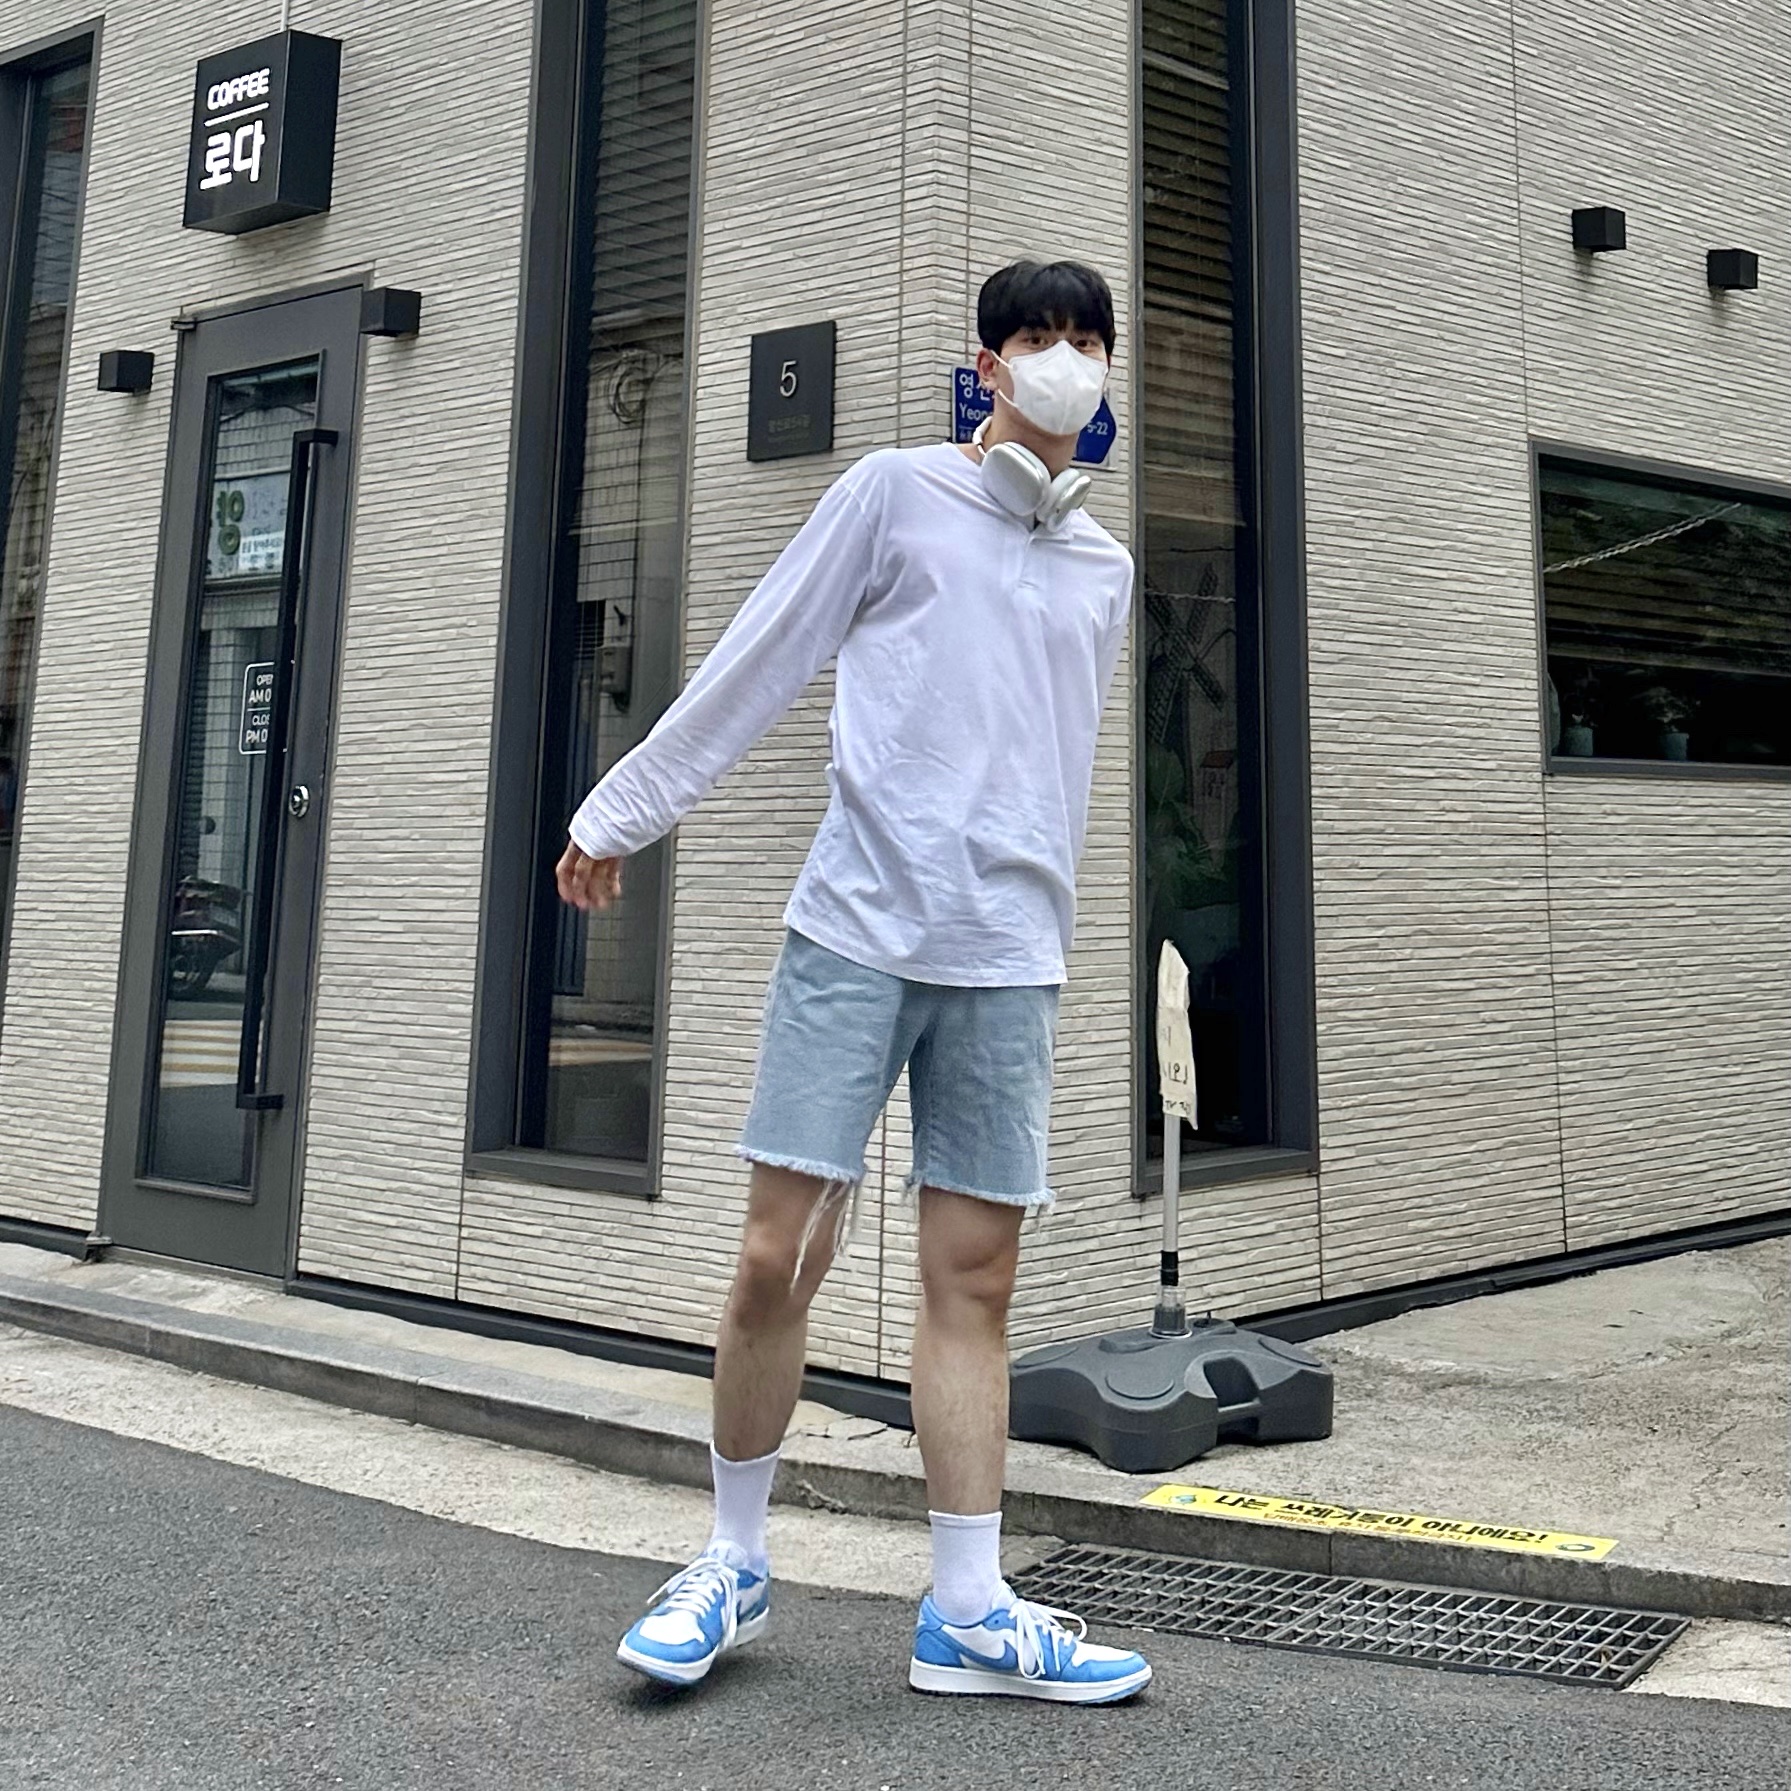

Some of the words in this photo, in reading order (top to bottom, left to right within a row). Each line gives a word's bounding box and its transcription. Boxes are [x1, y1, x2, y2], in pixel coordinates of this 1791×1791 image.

[207, 68, 270, 110] COFFEE
[200, 119, 266, 190] 로다
[780, 360, 797, 397] 5
[959, 402, 994, 421] Yeon
[249, 689, 263, 703] AM
[246, 730, 260, 743] PM
[1214, 1495, 1270, 1511] 나는
[1422, 1520, 1549, 1543] 아니에요!
